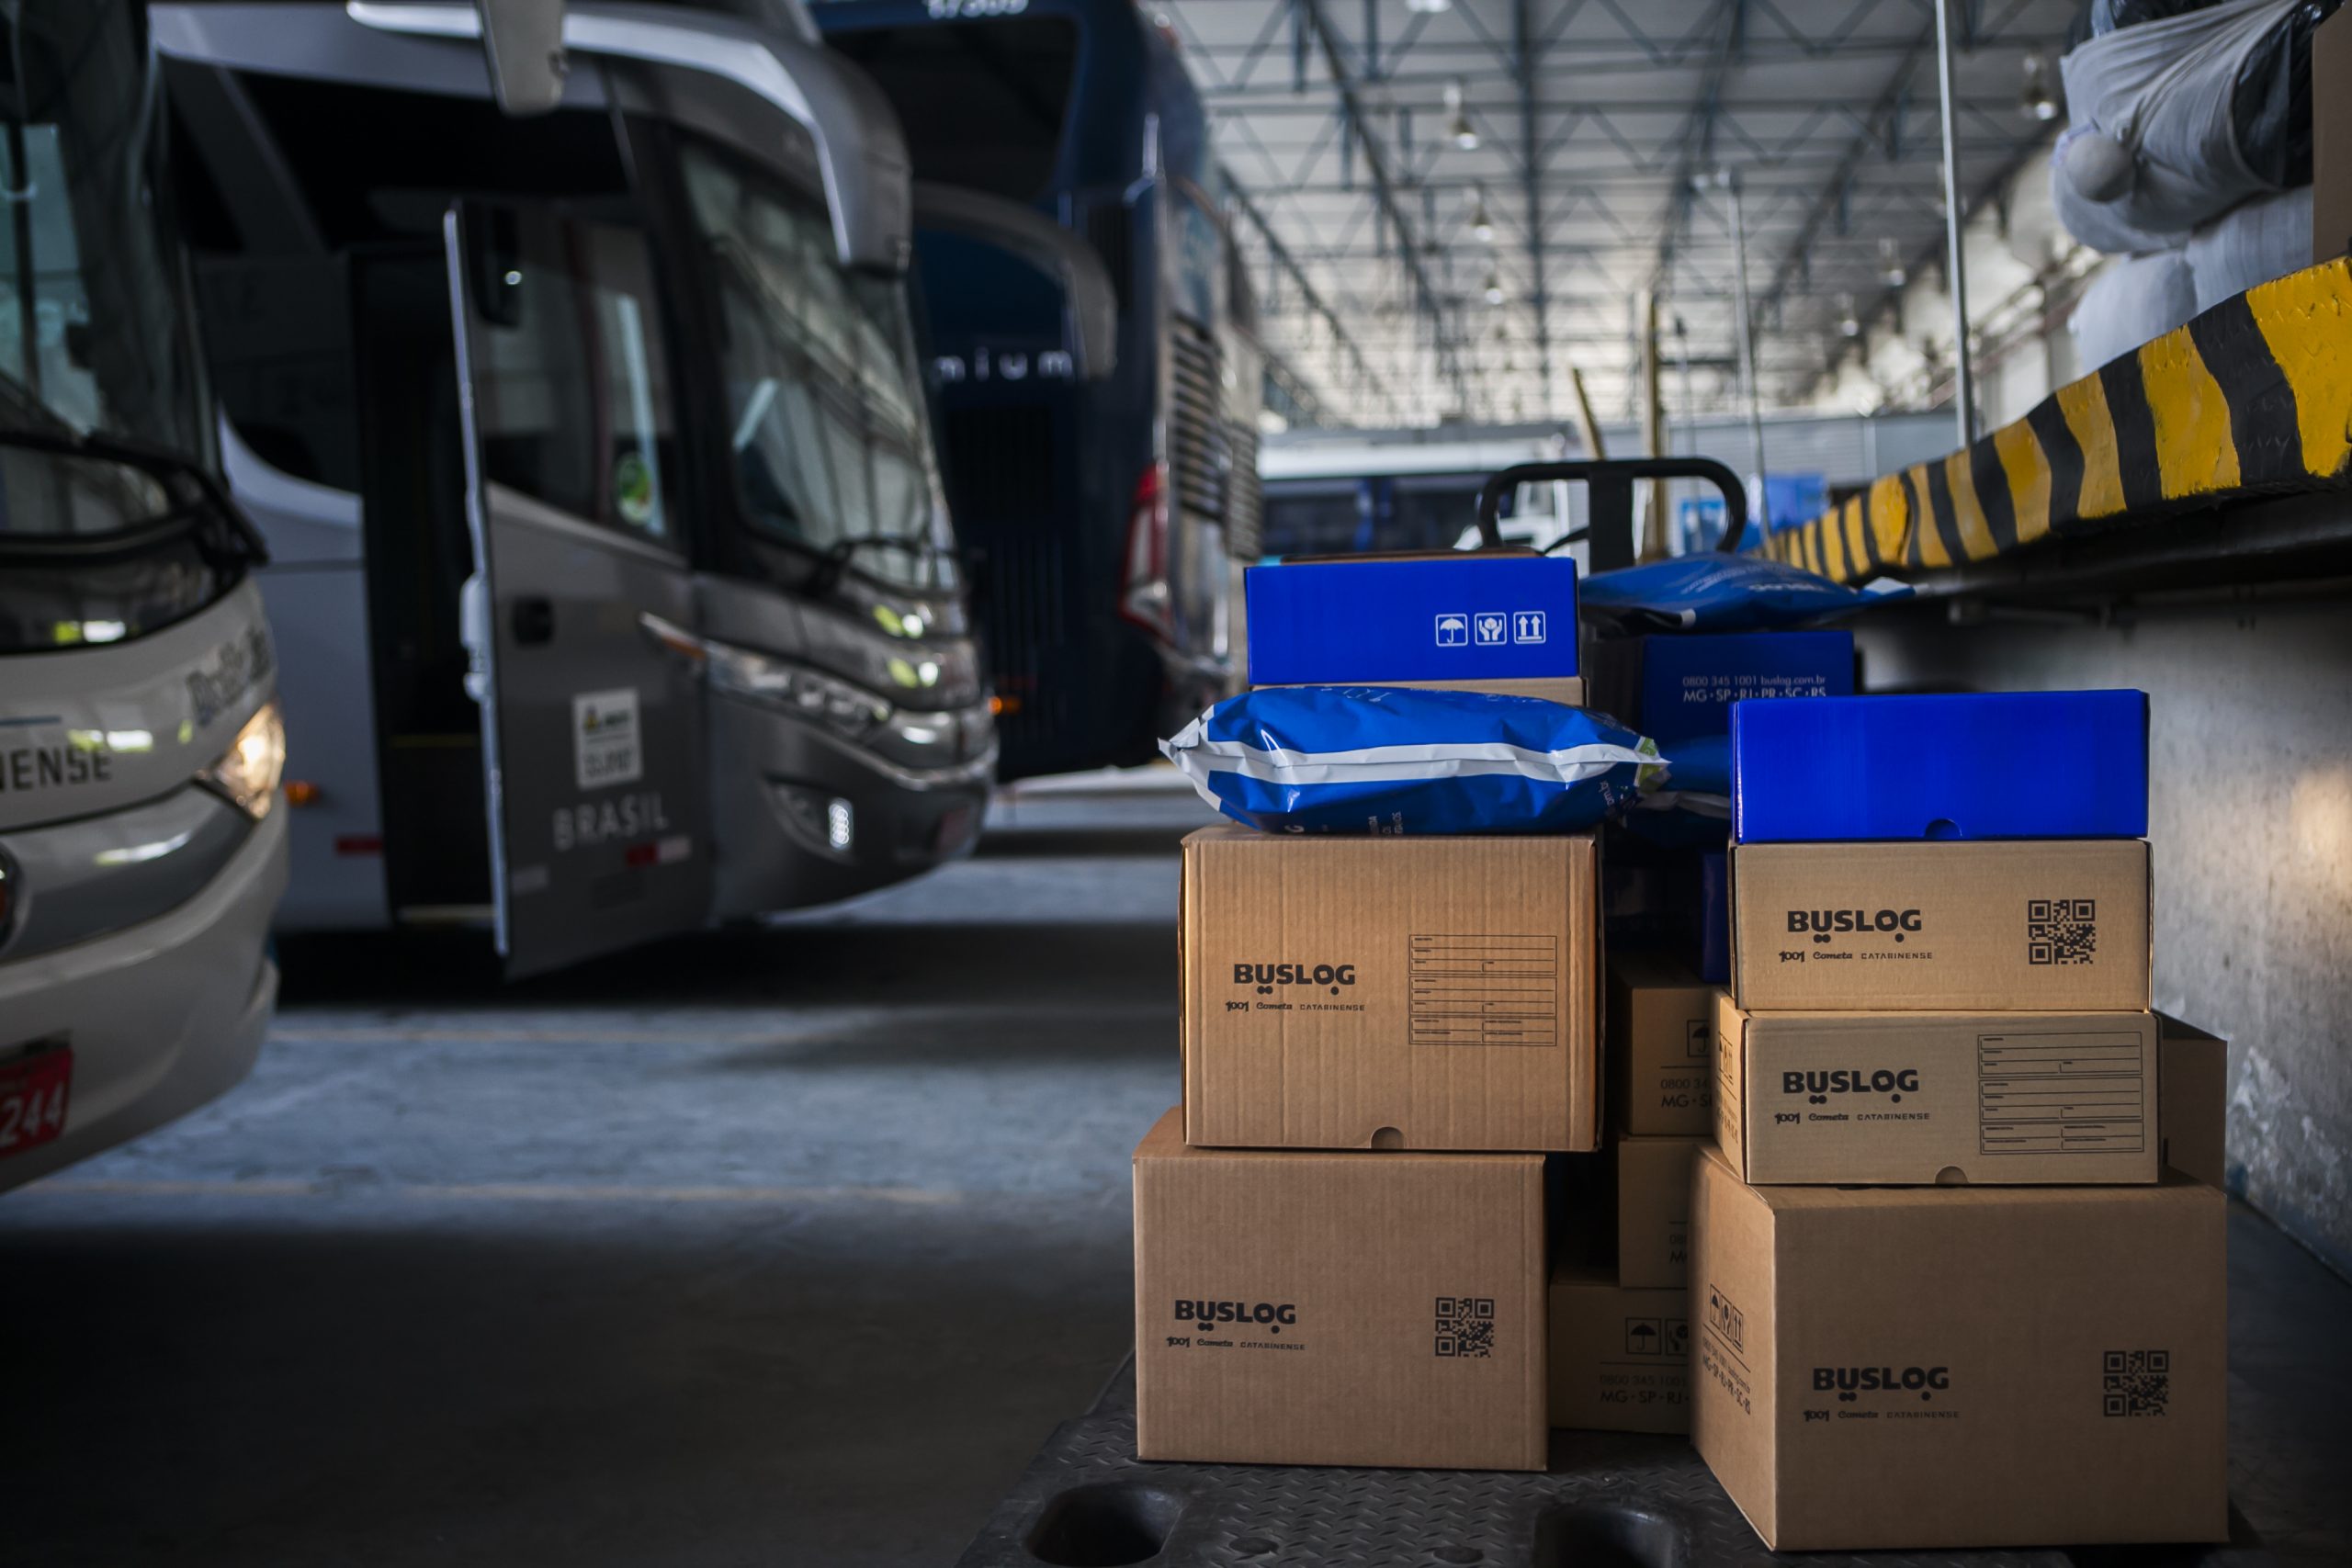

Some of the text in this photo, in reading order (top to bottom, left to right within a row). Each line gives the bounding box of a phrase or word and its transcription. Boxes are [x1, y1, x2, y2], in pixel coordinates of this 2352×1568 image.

[1682, 676, 1708, 687] 0800
[1734, 675, 1757, 686] 1001
[1760, 674, 1826, 687] buslog.com.br
[1682, 688, 1707, 703] MG
[1715, 688, 1731, 702] SP
[552, 792, 669, 852] BRASIL
[1787, 909, 1922, 932] BUSLOG
[1779, 951, 1805, 963] 1001
[1813, 951, 1853, 960] Cometa
[1234, 964, 1356, 986] BUSLOG
[1225, 1000, 1249, 1012] 1001
[1256, 1002, 1293, 1010] Cometa
[1661, 1078, 1690, 1089] 0800
[1783, 1069, 1919, 1094] BUSLOG
[1661, 1094, 1689, 1108] MG
[1774, 1112, 1801, 1124] 1001
[1808, 1112, 1849, 1122] Cometa
[1175, 1300, 1296, 1325] BUSLOG
[1813, 1367, 1950, 1391] BUSLOG
[1600, 1390, 1682, 1404] MG SP RJ
